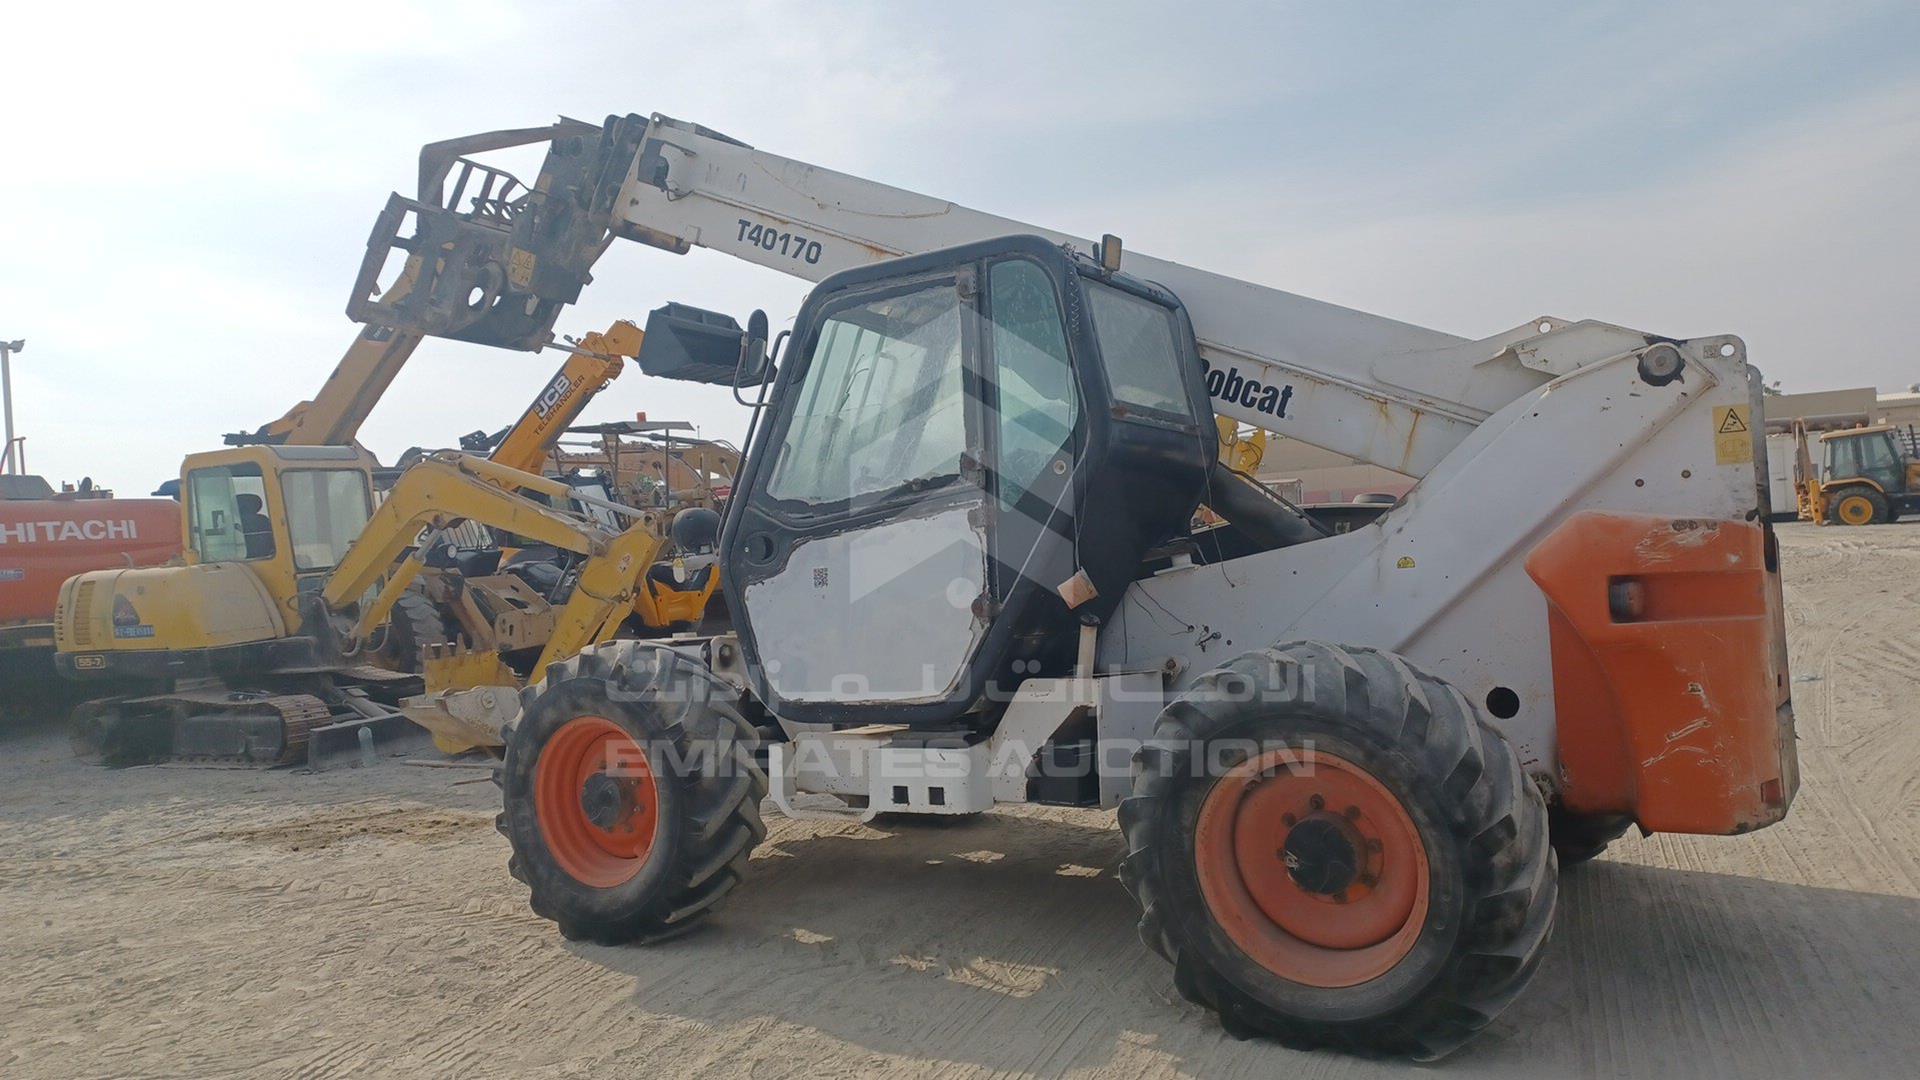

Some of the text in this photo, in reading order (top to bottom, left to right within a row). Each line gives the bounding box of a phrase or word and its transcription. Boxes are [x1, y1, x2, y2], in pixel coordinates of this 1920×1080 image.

[737, 218, 823, 265] T40170
[534, 375, 571, 418] JCB
[534, 374, 585, 436] TELEHANDLER
[0, 519, 138, 545] HITACHI
